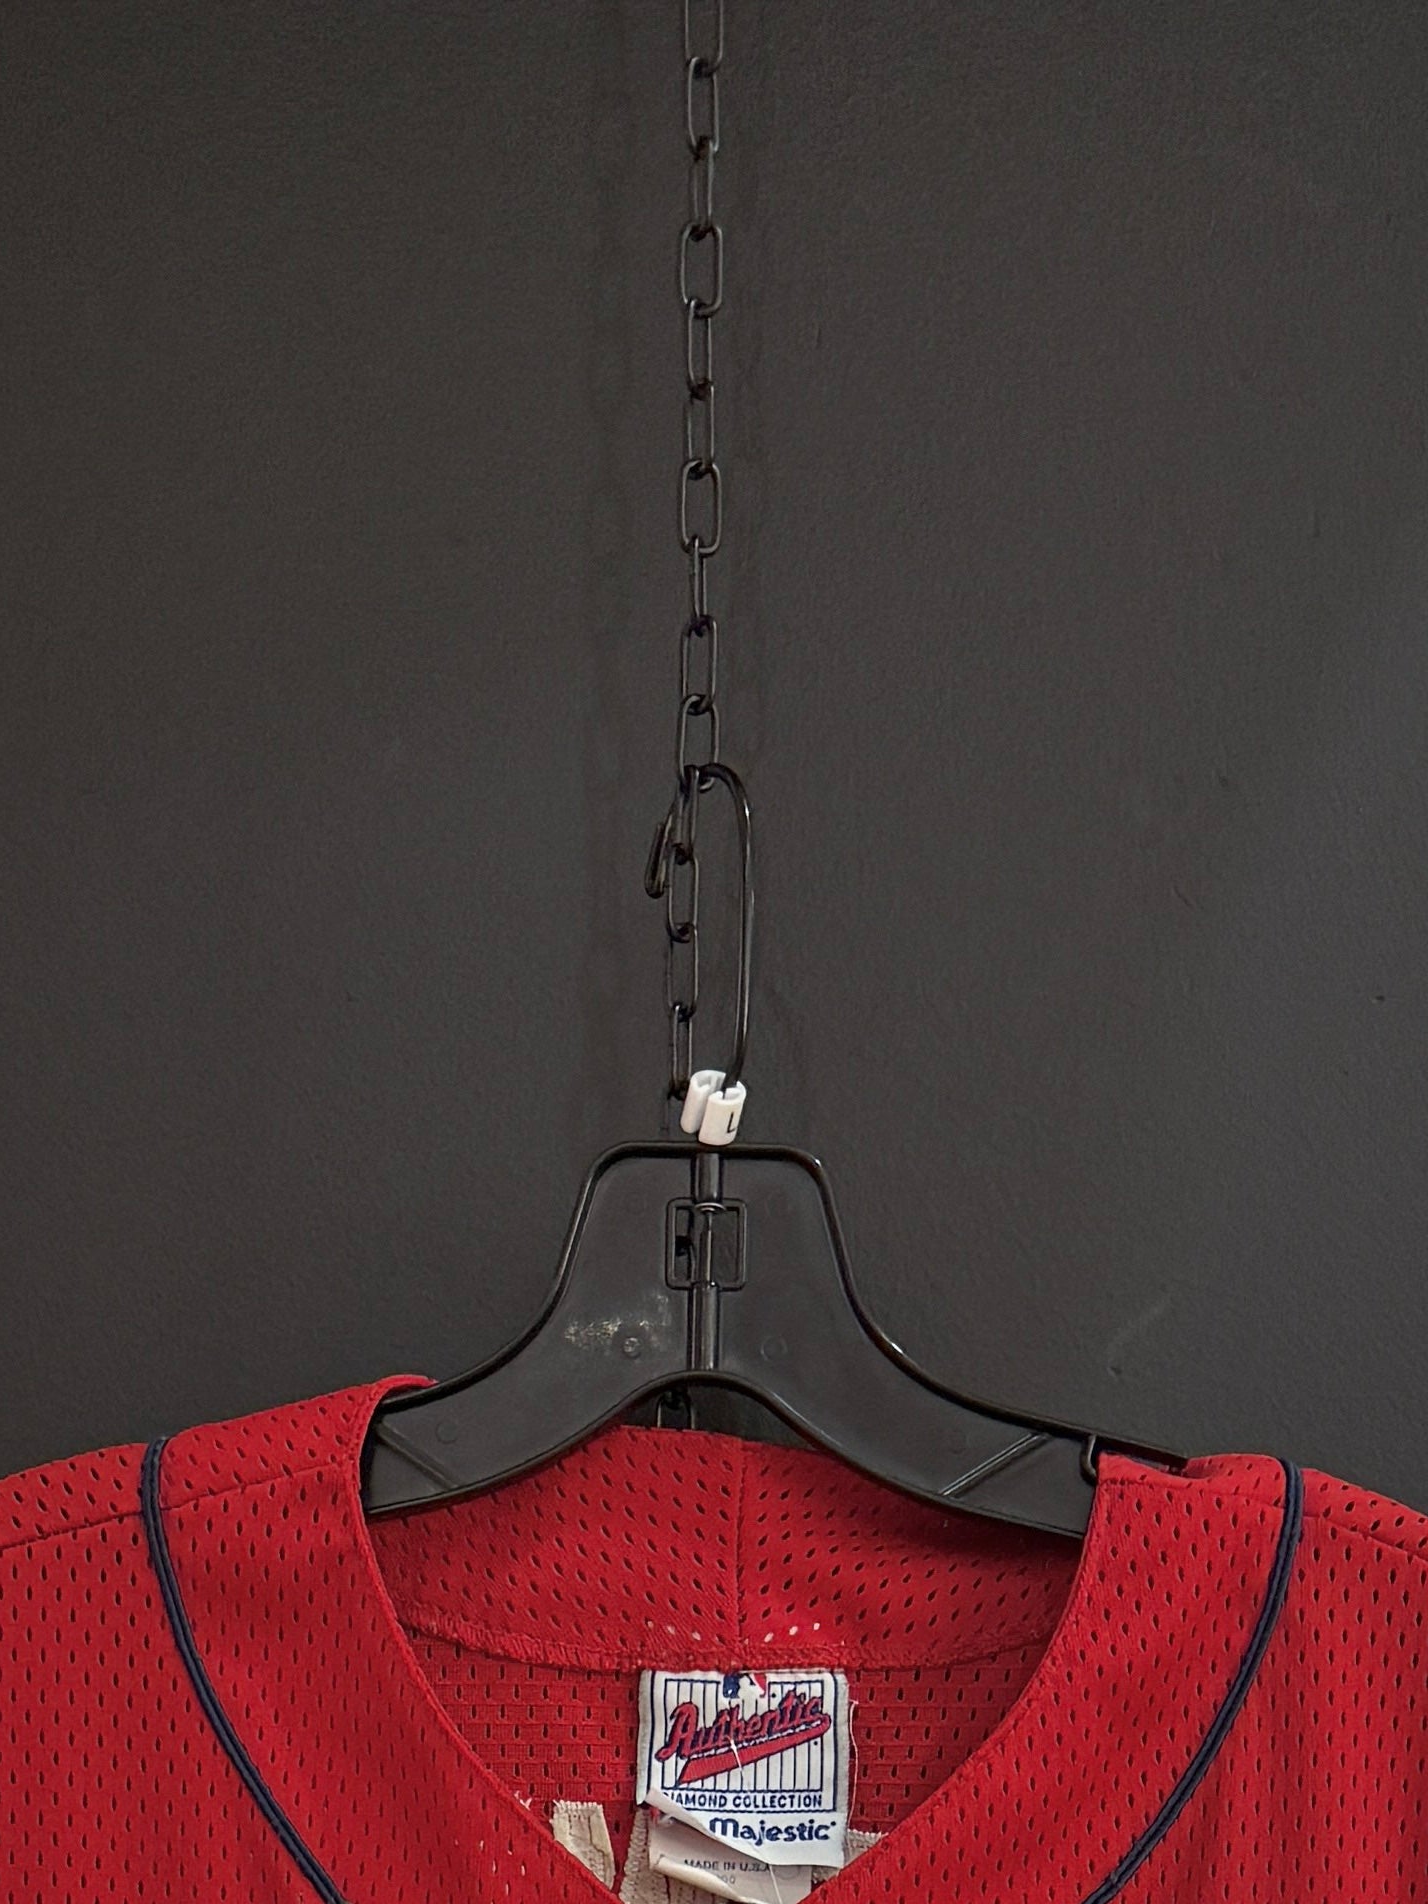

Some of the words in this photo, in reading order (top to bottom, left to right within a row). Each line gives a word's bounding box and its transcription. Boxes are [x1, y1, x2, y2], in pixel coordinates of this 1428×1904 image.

[654, 1687, 830, 1763] Authentic
[662, 1791, 727, 1808] IAMOND
[733, 1794, 822, 1809] COLLECTION
[723, 1861, 737, 1872] IN
